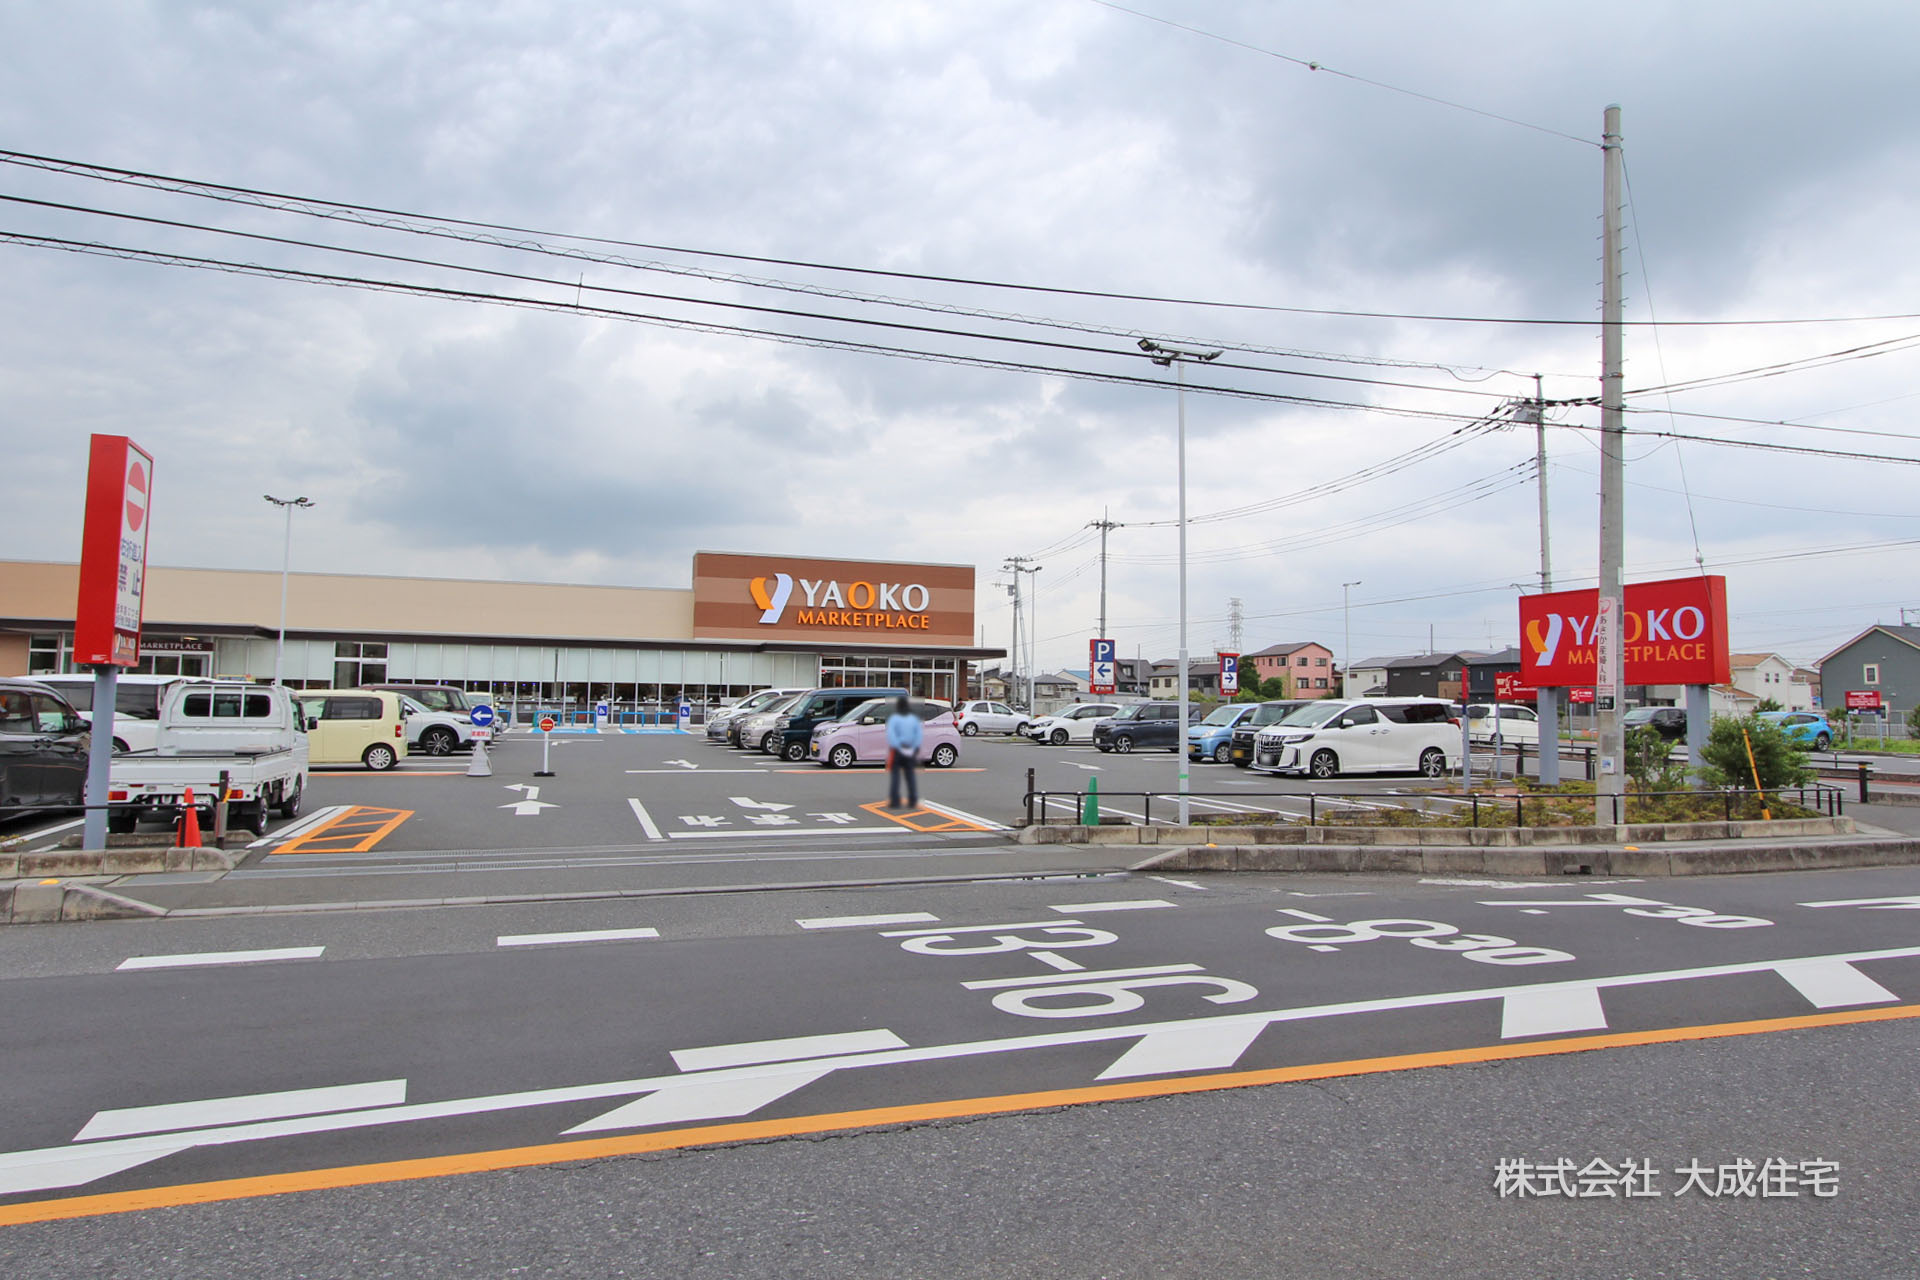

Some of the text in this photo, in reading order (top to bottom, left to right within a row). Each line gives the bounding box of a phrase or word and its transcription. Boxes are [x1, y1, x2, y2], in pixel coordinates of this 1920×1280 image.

[799, 579, 930, 612] YAOKO
[797, 610, 930, 629] MARKETPLACE
[1098, 642, 1110, 661] P
[1568, 643, 1706, 665] MAETPLACE
[1225, 658, 1234, 671] P
